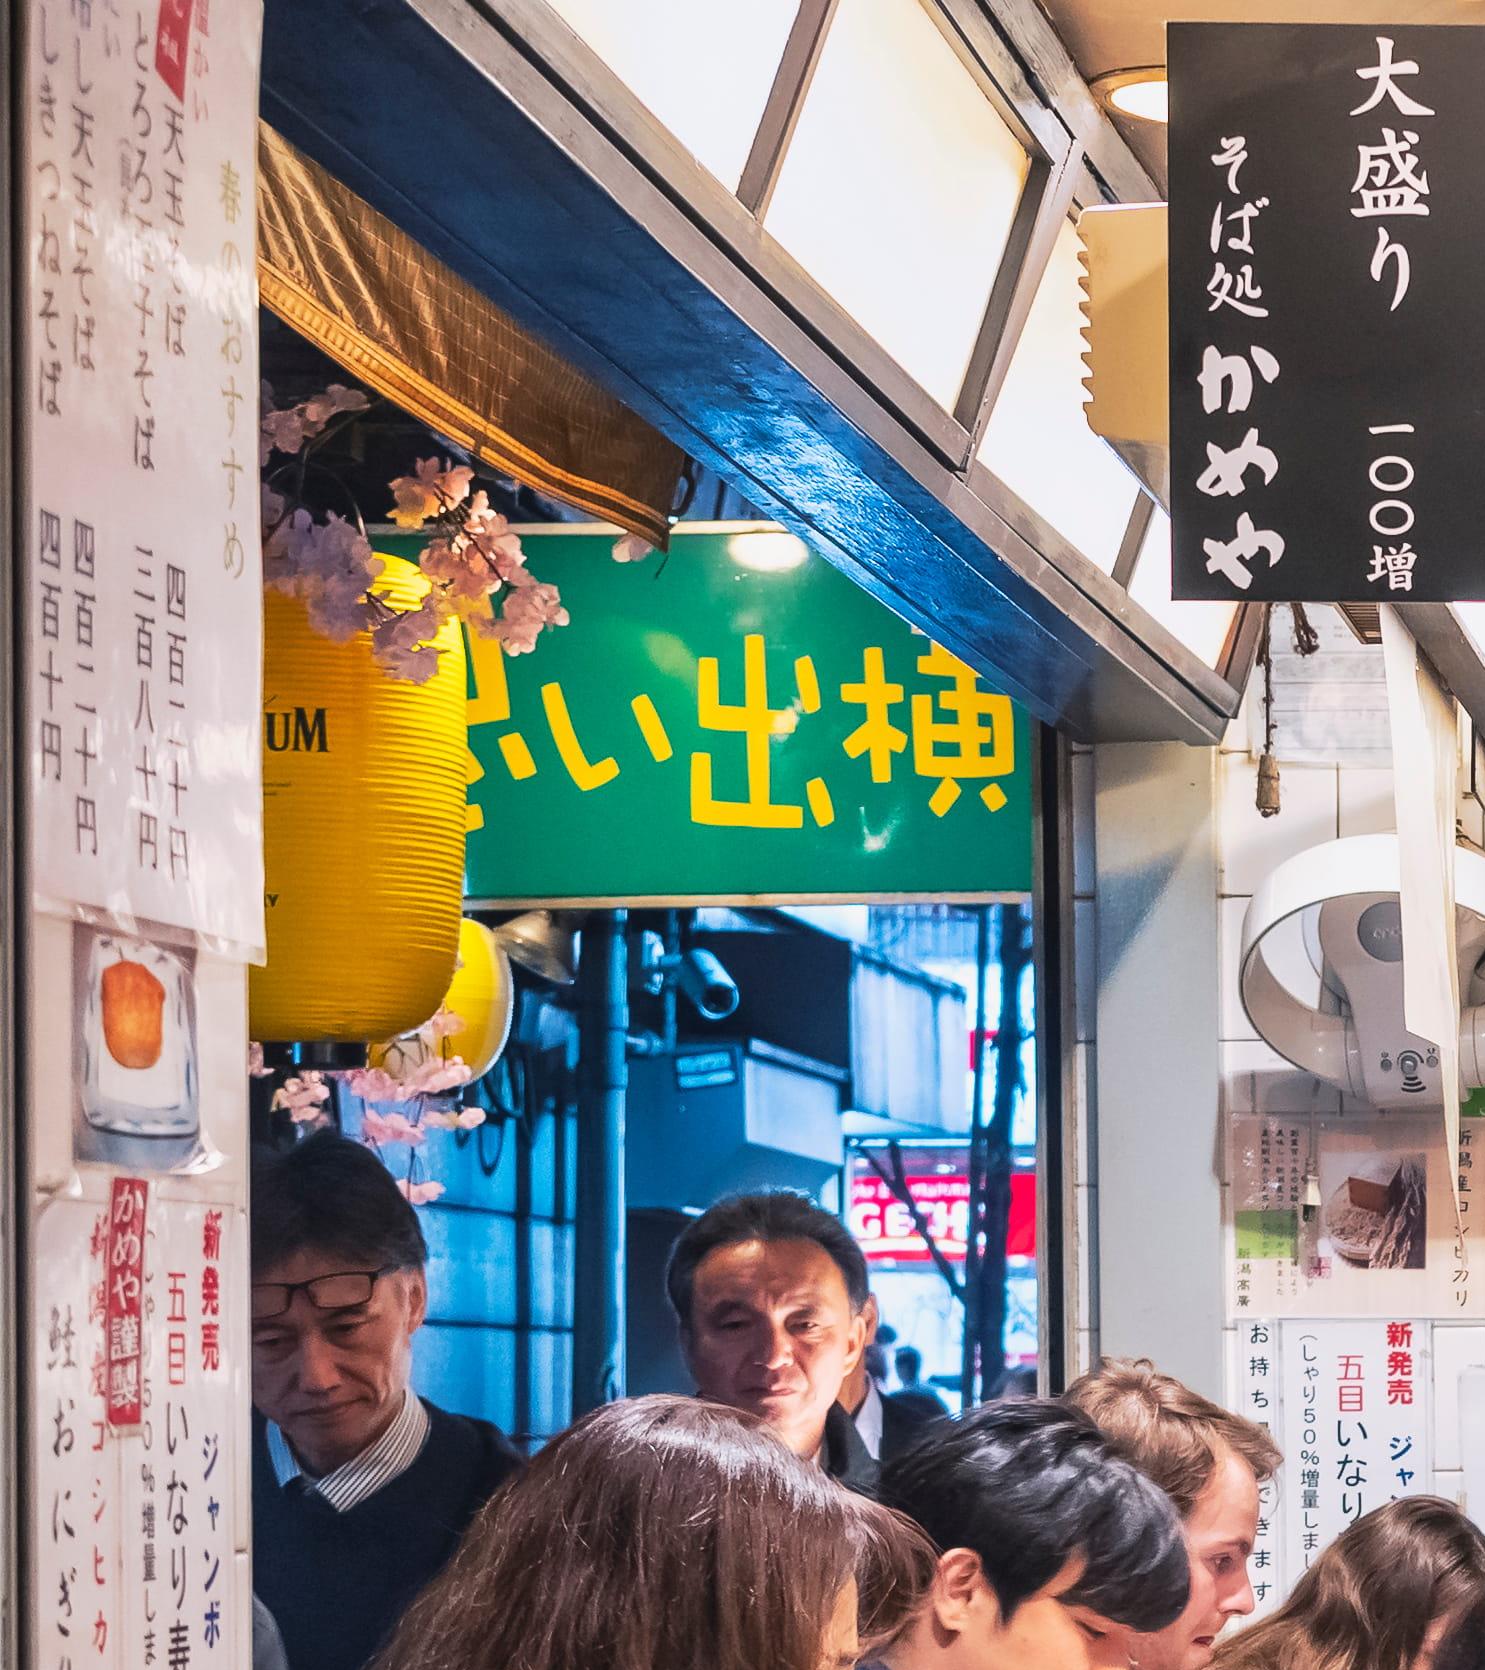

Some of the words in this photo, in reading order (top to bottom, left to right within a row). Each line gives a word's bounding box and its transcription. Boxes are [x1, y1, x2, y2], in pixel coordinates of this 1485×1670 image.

[1349, 36, 1436, 312] 大盛り
[39, 507, 63, 781] 四百十円
[74, 518, 98, 856] 四百二十円
[201, 1209, 222, 1372] 新発売
[1386, 1322, 1414, 1405] 新発売
[1389, 1435, 1415, 1500] ジャ
